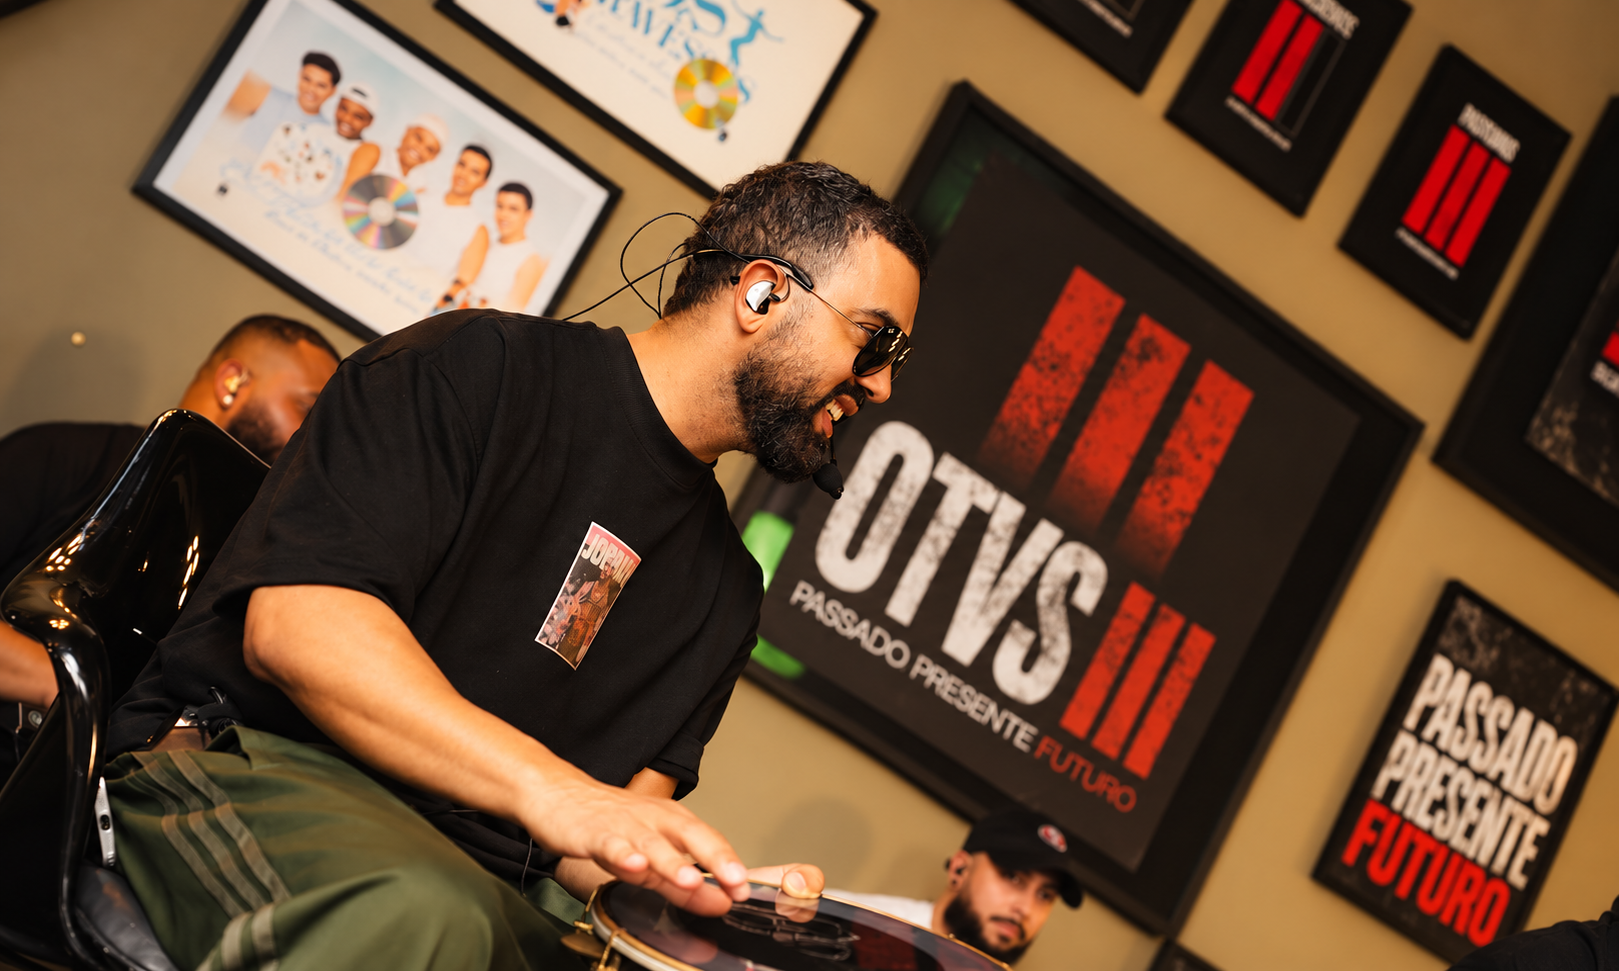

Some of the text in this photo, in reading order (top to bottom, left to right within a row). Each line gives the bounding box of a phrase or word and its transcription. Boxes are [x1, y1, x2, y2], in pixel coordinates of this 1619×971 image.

[815, 421, 1108, 704] OTVS
[790, 581, 1137, 813] PASSADO PRESENTE FUTURO
[1402, 653, 1577, 814] PASSADO
[1342, 799, 1510, 947] FUTURO
[1371, 730, 1551, 890] PRESENTE
